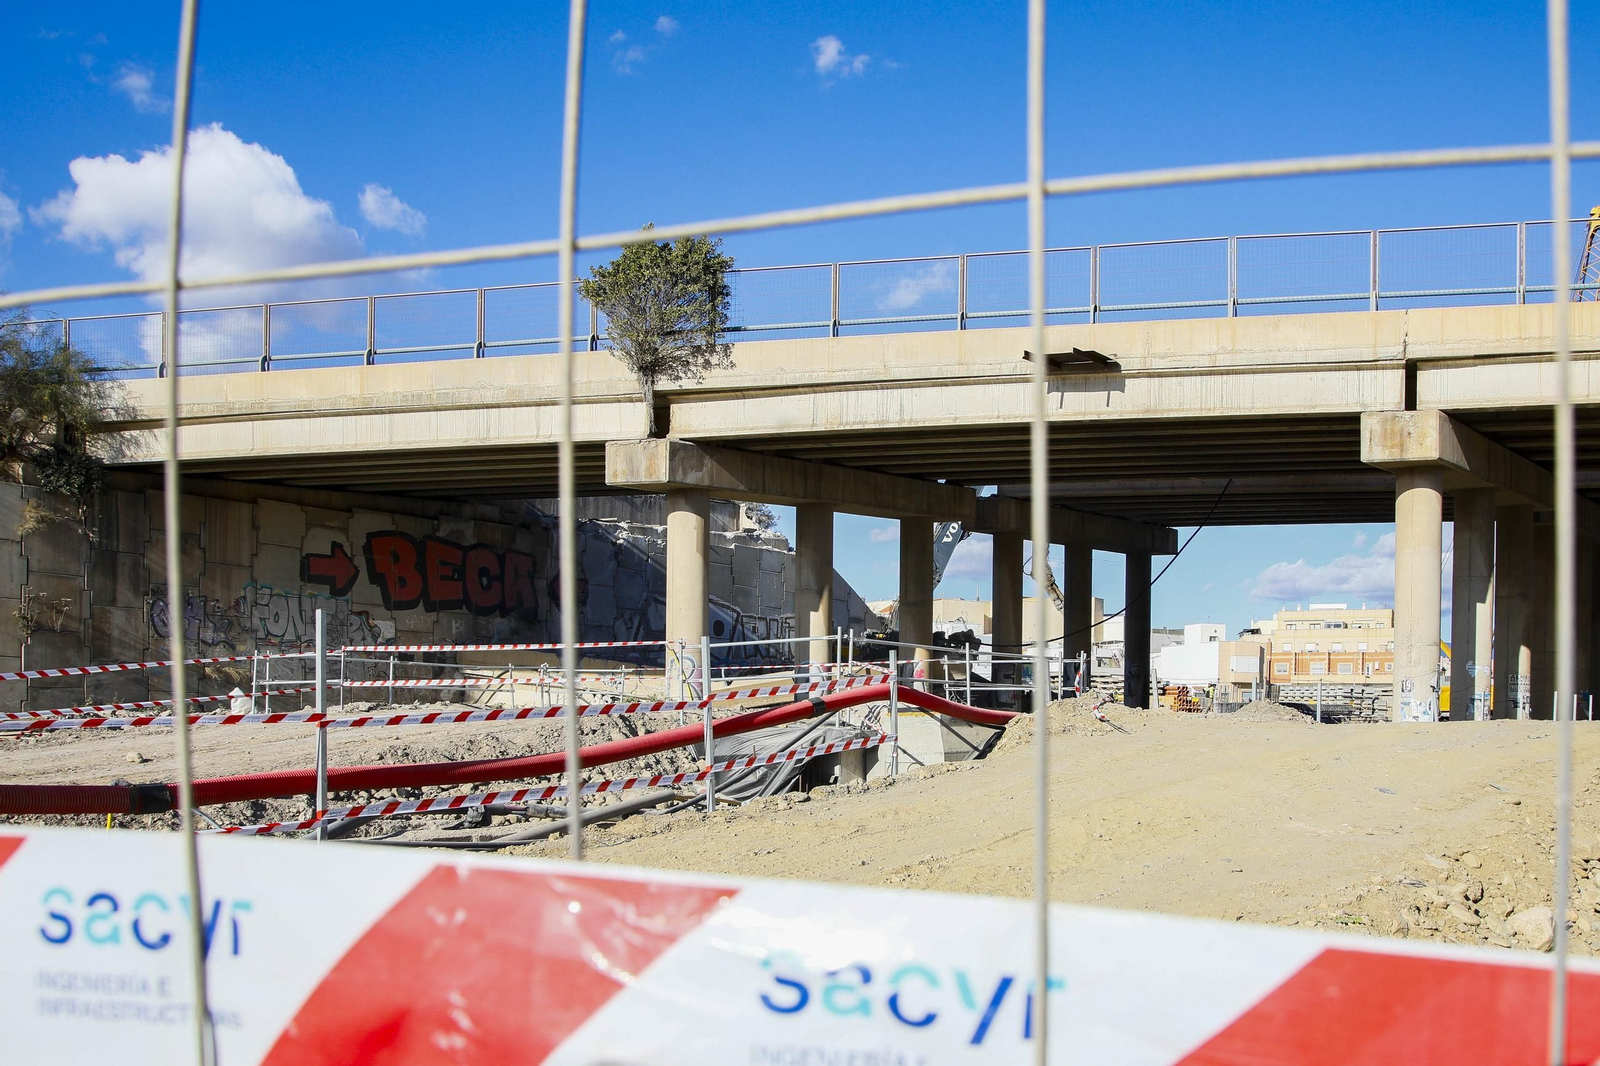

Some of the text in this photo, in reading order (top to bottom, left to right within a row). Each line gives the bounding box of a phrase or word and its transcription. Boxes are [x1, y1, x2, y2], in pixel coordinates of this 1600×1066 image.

[943, 521, 961, 543] VO
[364, 530, 540, 620] BECA
[39, 886, 253, 962] sacyr
